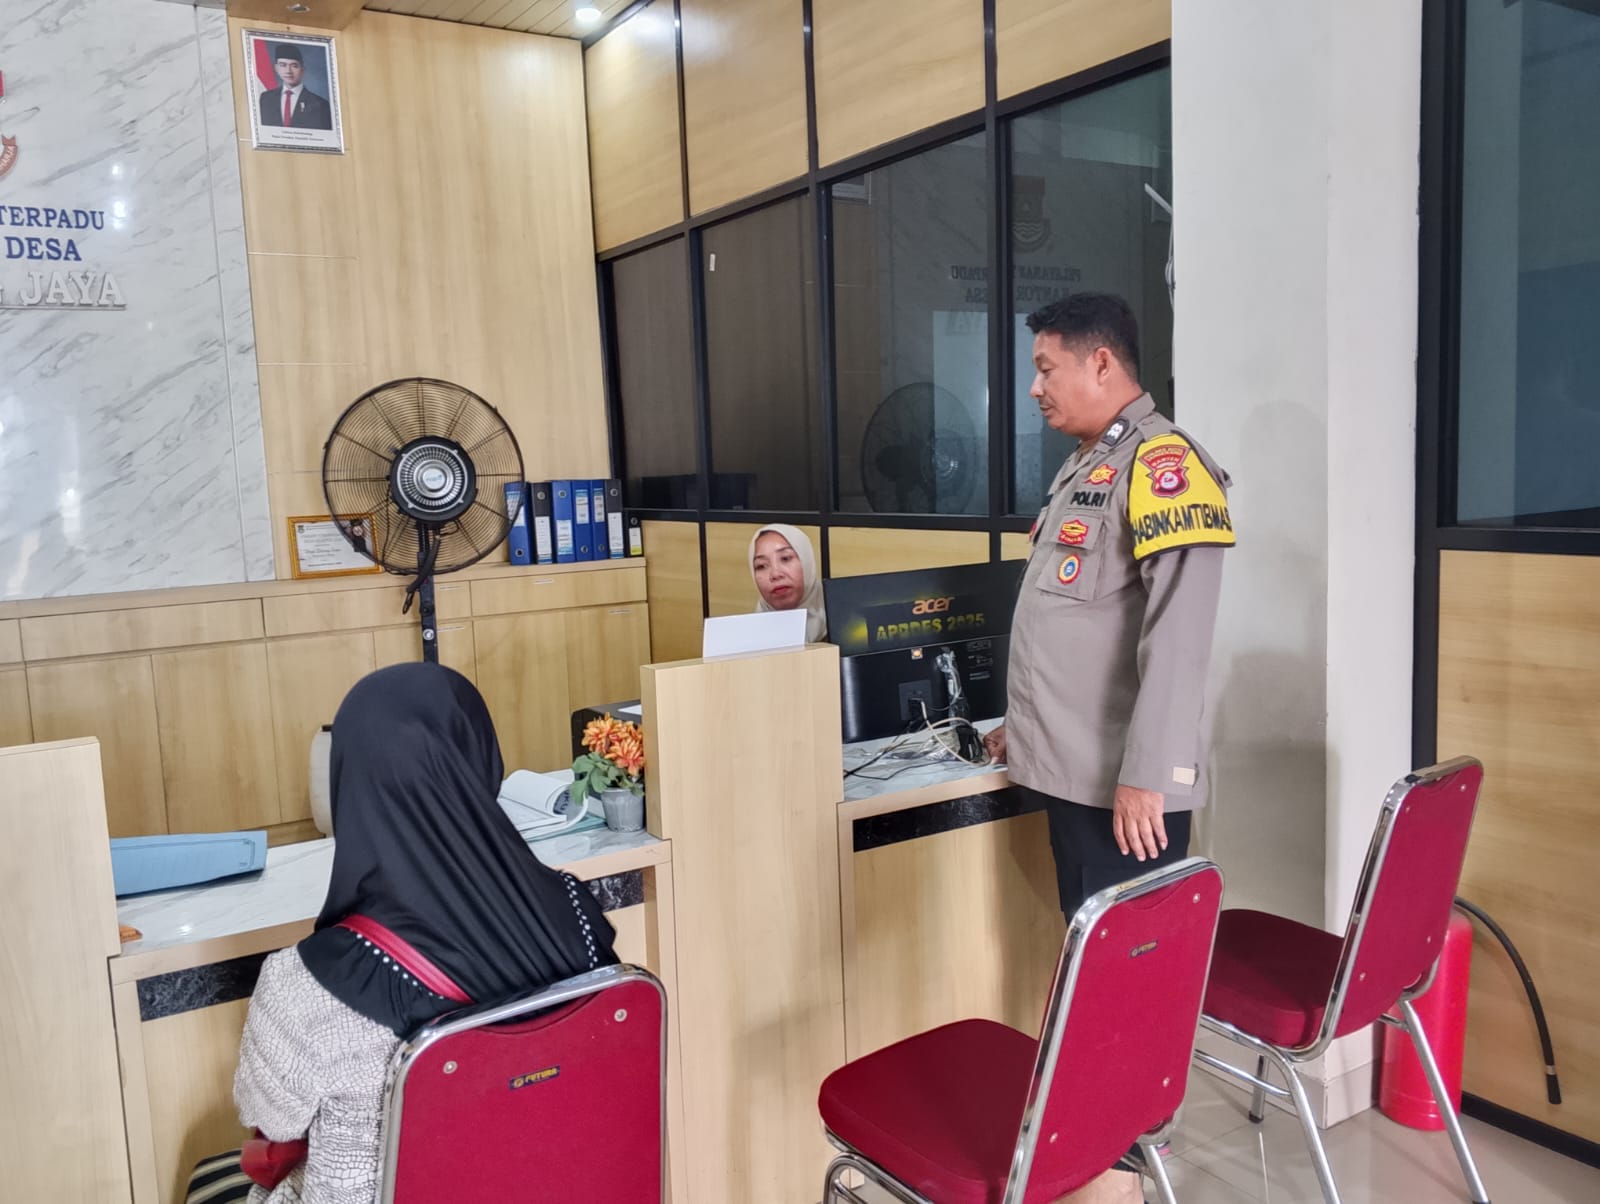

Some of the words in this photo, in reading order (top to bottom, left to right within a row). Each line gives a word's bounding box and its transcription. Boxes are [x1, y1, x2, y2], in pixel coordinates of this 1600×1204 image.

[0, 205, 105, 230] TERPADU
[4, 236, 82, 261] DESA
[19, 272, 126, 306] JAYA
[1069, 490, 1107, 508] POLRI
[912, 596, 956, 615] acer
